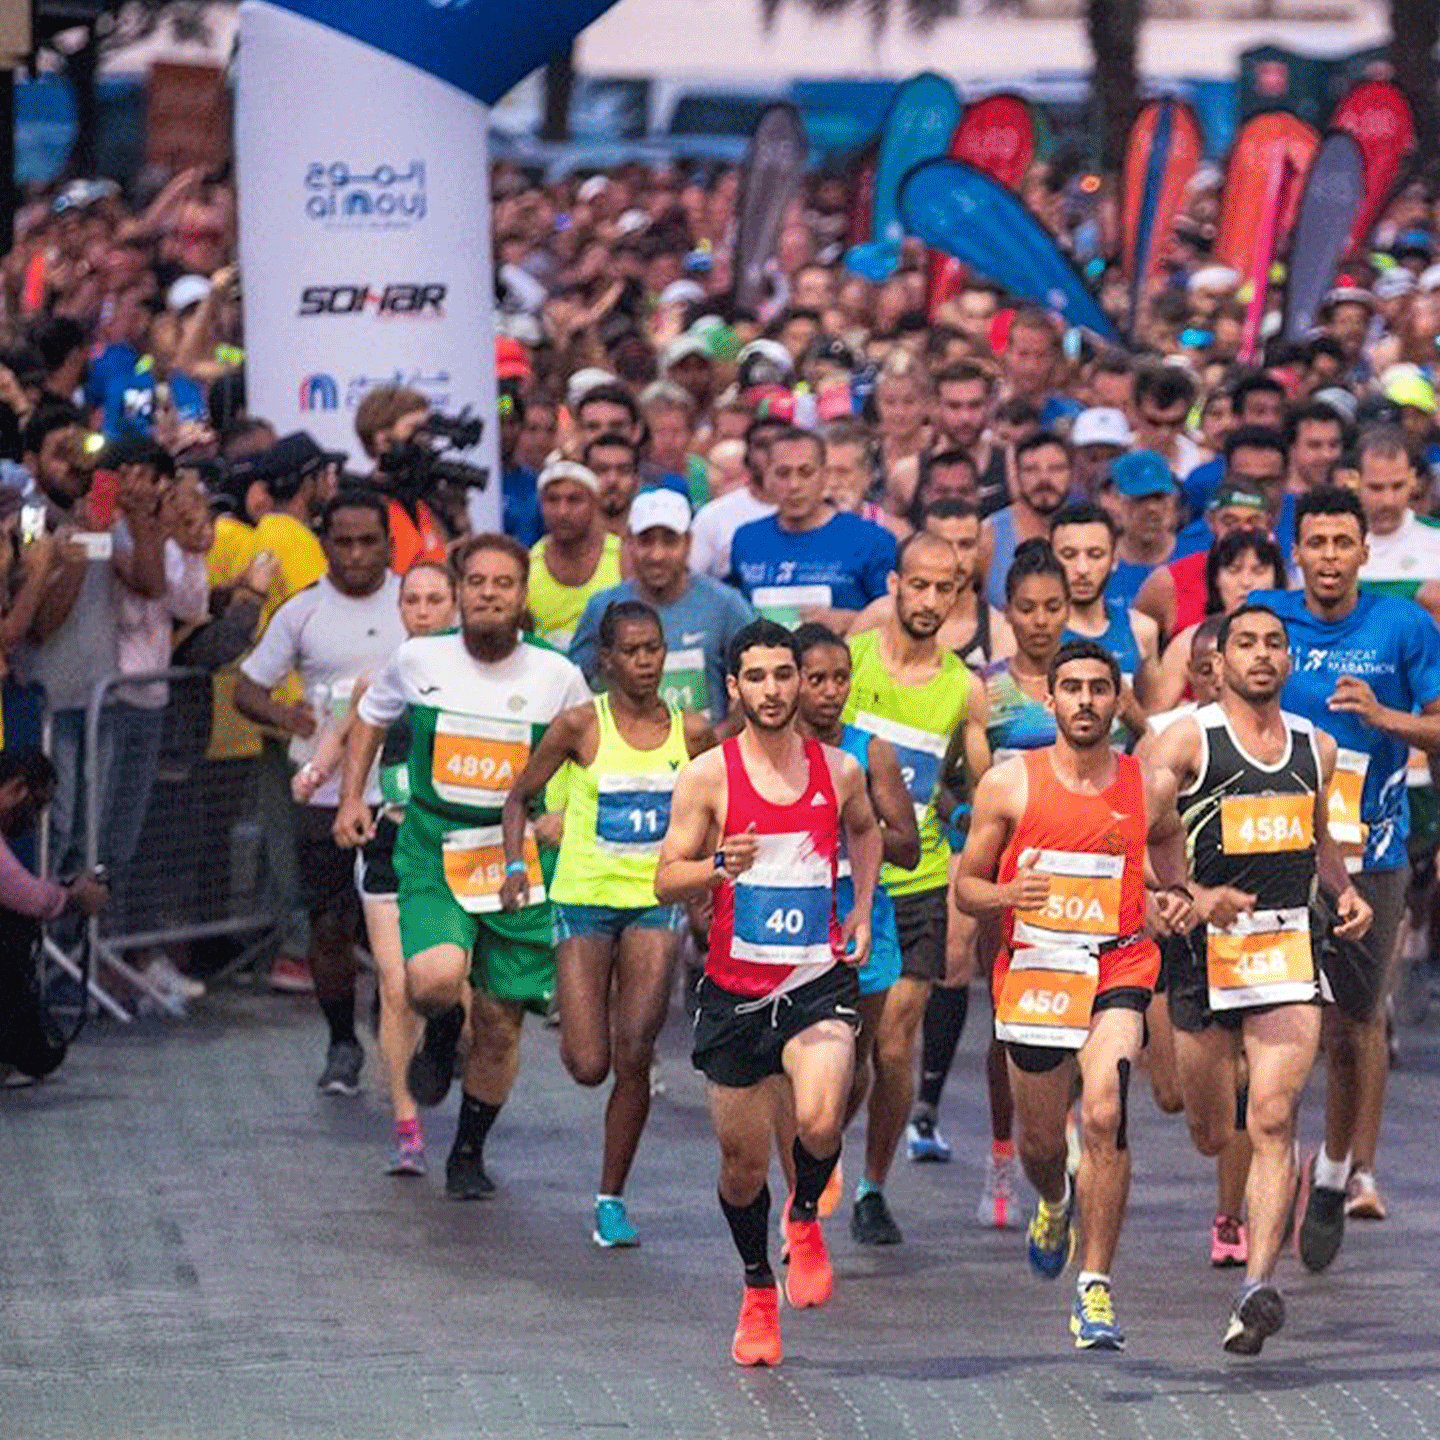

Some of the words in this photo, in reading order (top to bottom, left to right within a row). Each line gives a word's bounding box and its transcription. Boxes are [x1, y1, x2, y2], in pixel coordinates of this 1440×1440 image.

[1328, 661, 1395, 675] MARATHON
[446, 754, 513, 783] 489A
[629, 809, 657, 833] 11
[1239, 815, 1304, 843] 458A
[765, 908, 804, 934] 40
[1039, 894, 1104, 922] 50A
[1231, 949, 1286, 976] 458
[1018, 988, 1071, 1015] 450
